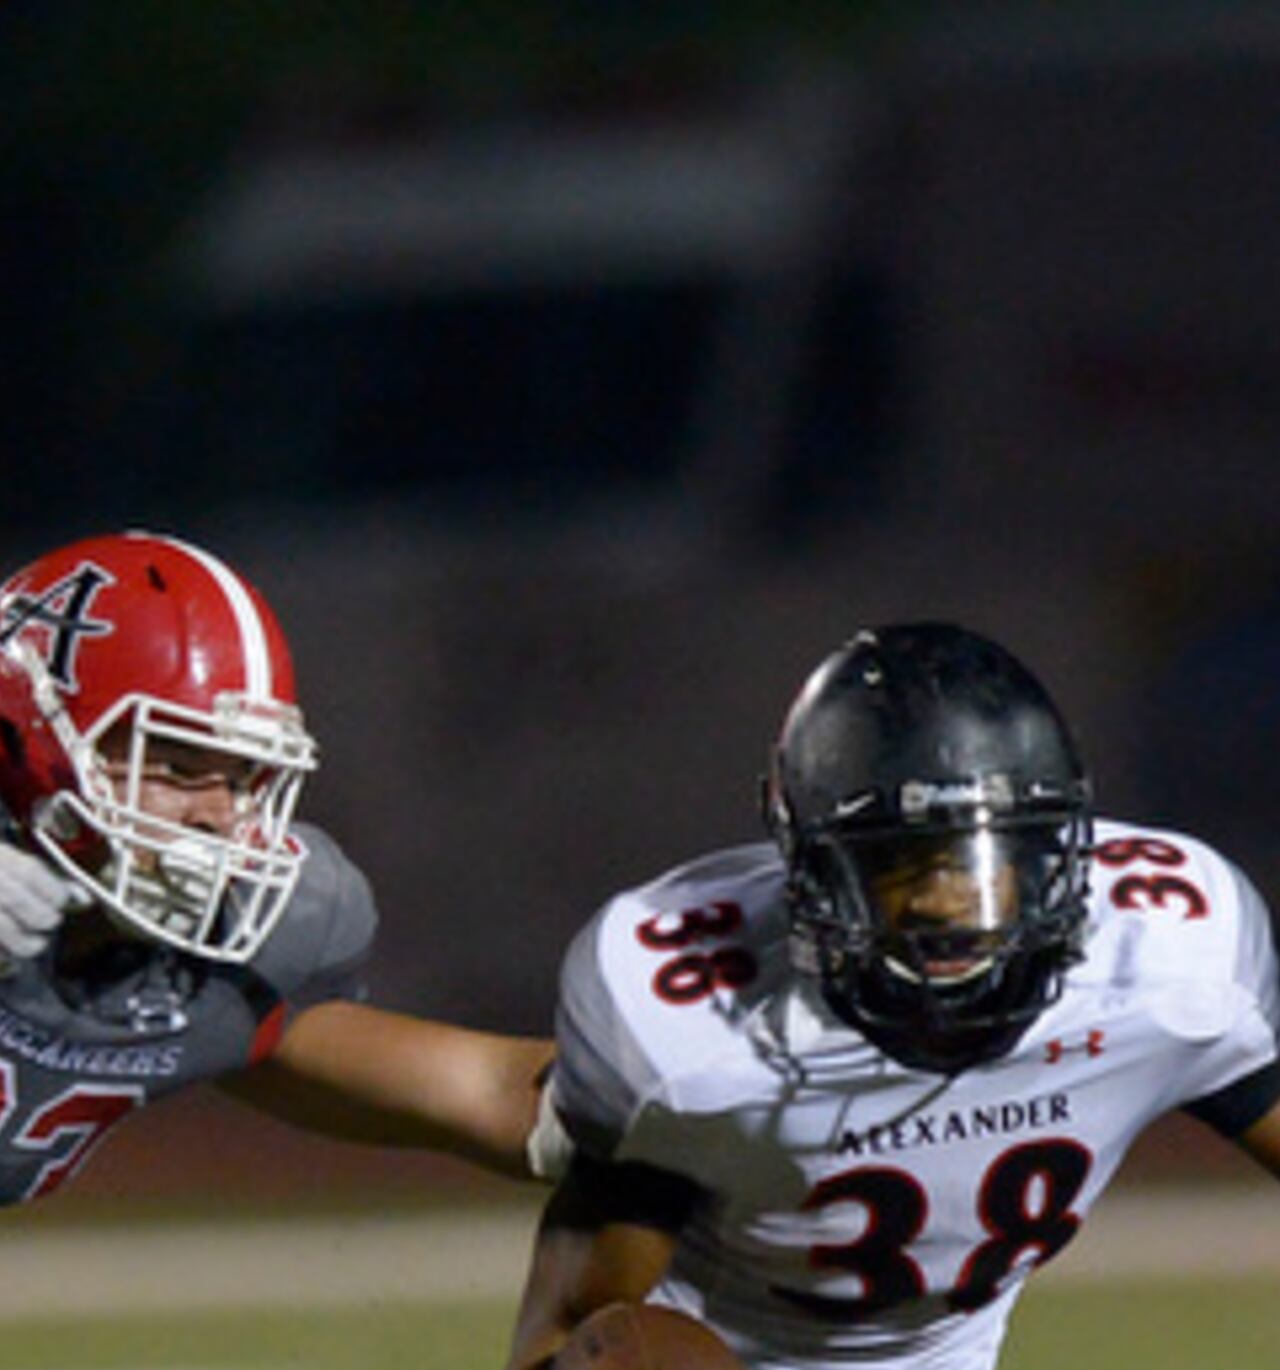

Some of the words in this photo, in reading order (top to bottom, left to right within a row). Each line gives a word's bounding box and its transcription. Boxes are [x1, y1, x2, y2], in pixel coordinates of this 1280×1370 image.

[1092, 836, 1210, 921] 38
[835, 1093, 1070, 1156] ALEXANDER
[800, 1136, 1094, 1322] 38
